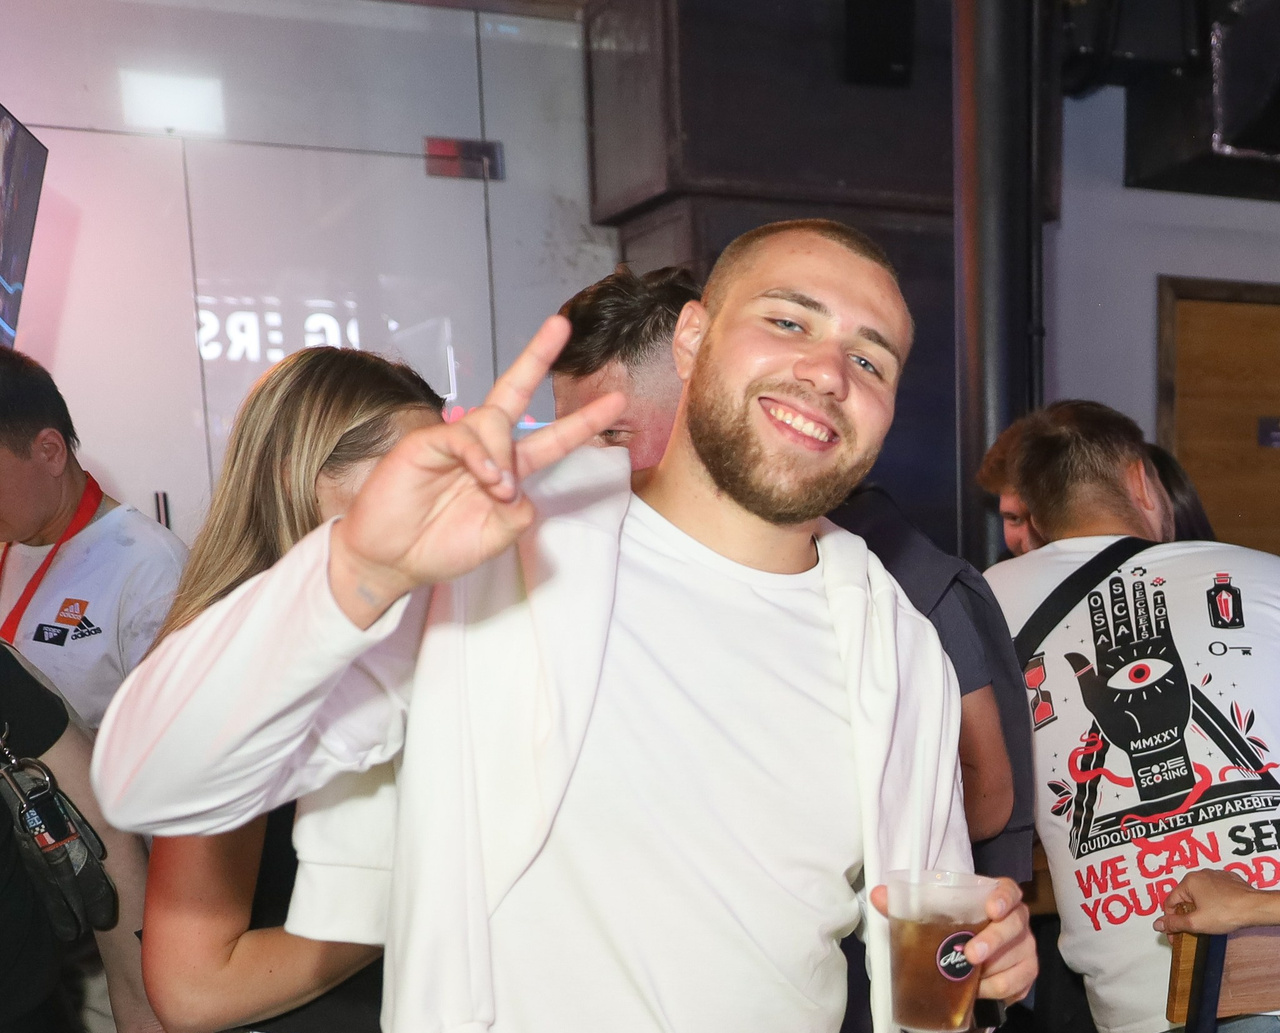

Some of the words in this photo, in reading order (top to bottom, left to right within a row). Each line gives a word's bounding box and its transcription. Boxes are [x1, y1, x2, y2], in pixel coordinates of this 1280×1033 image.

[71, 627, 102, 641] adidas
[1090, 595, 1109, 646] OSA
[1112, 582, 1130, 637] SCA
[1134, 581, 1149, 640] SECRETS
[1130, 726, 1178, 751] MMXXV
[1140, 765, 1188, 788] SCORING
[1080, 824, 1146, 854] QUIDQUID
[1149, 811, 1194, 834] LATET
[1198, 796, 1274, 822] APPAREBIT
[1075, 854, 1130, 899] WE
[1136, 831, 1221, 879] CAN
